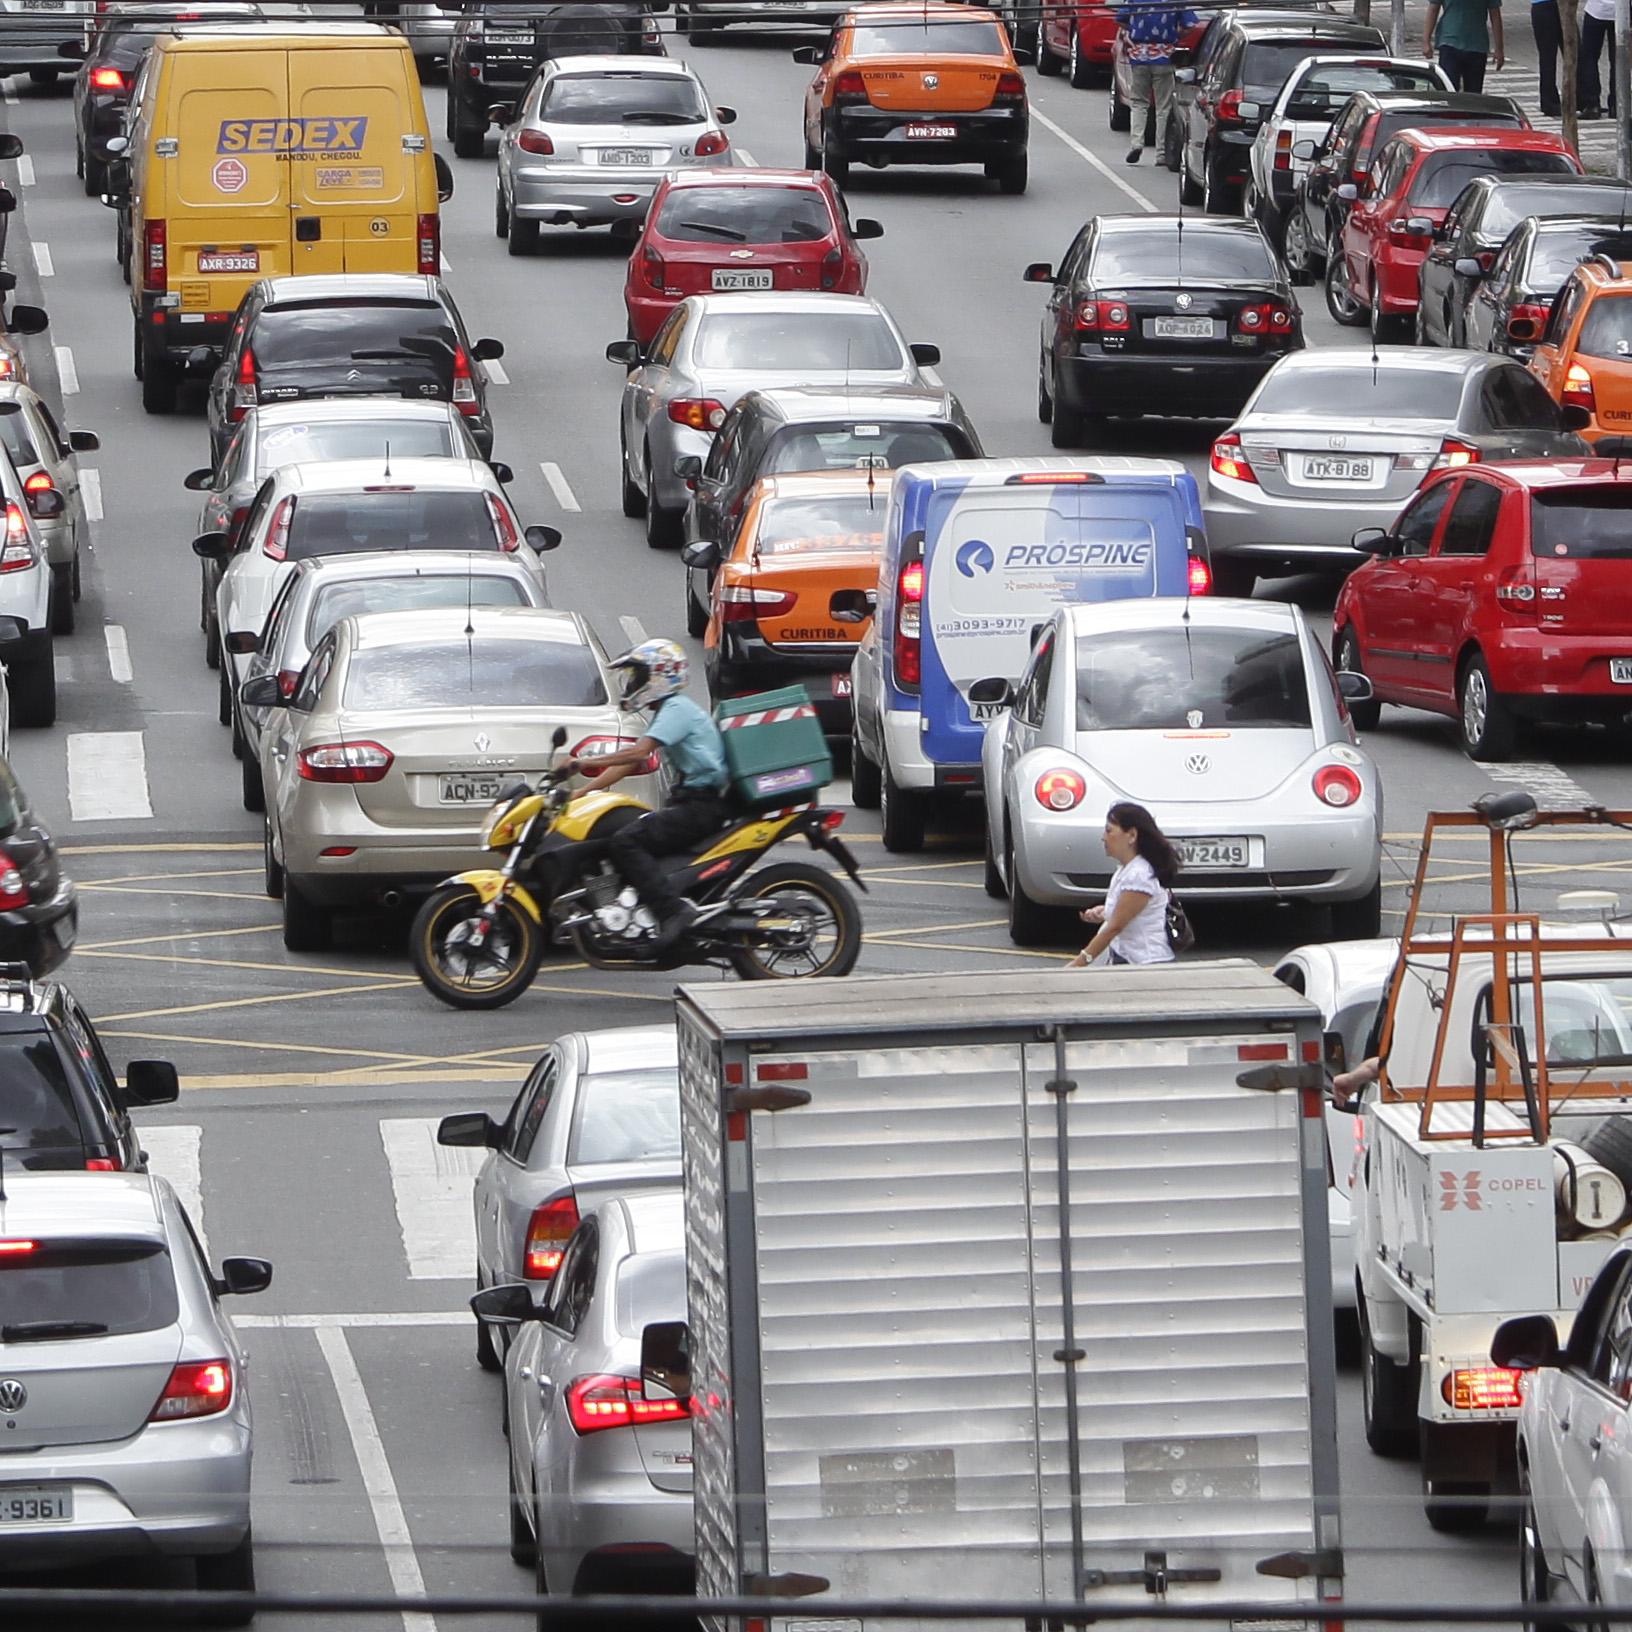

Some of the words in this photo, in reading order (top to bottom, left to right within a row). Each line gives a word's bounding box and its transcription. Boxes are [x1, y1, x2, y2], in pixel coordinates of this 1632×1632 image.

[862, 71, 905, 80] CURITIBA
[221, 119, 362, 152] SEDEX
[371, 221, 388, 232] 03
[1003, 539, 1152, 566] PRÓSPINE
[779, 628, 848, 640] CURITIBA
[444, 784, 502, 801] ACN-92
[1178, 846, 1244, 864] V-2449
[1488, 1178, 1547, 1193] COPEL
